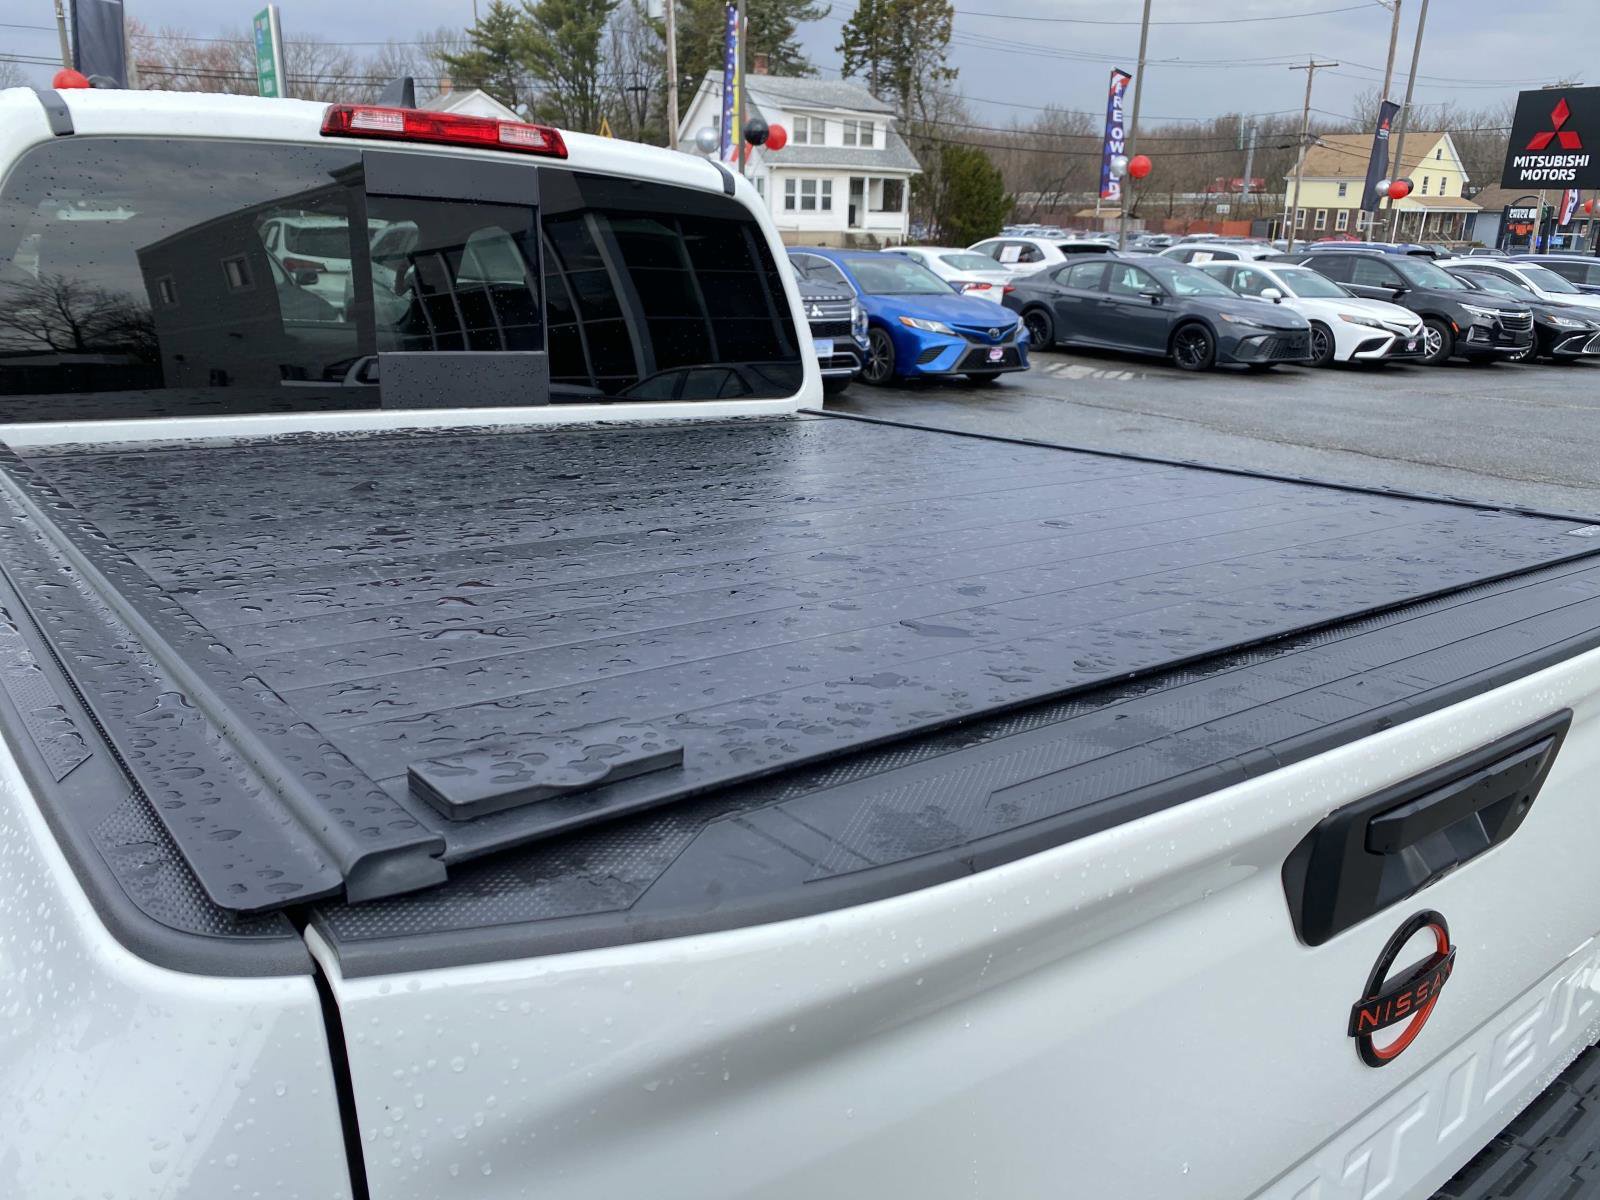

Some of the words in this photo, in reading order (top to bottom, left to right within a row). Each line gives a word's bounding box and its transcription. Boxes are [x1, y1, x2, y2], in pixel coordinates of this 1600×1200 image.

[1108, 127, 1125, 194] OWD
[1513, 154, 1590, 168] MITSUBISHI
[1520, 168, 1577, 181] MOTORS
[1358, 961, 1453, 1031] NISSAN
[1293, 957, 1599, 1200] TIER
